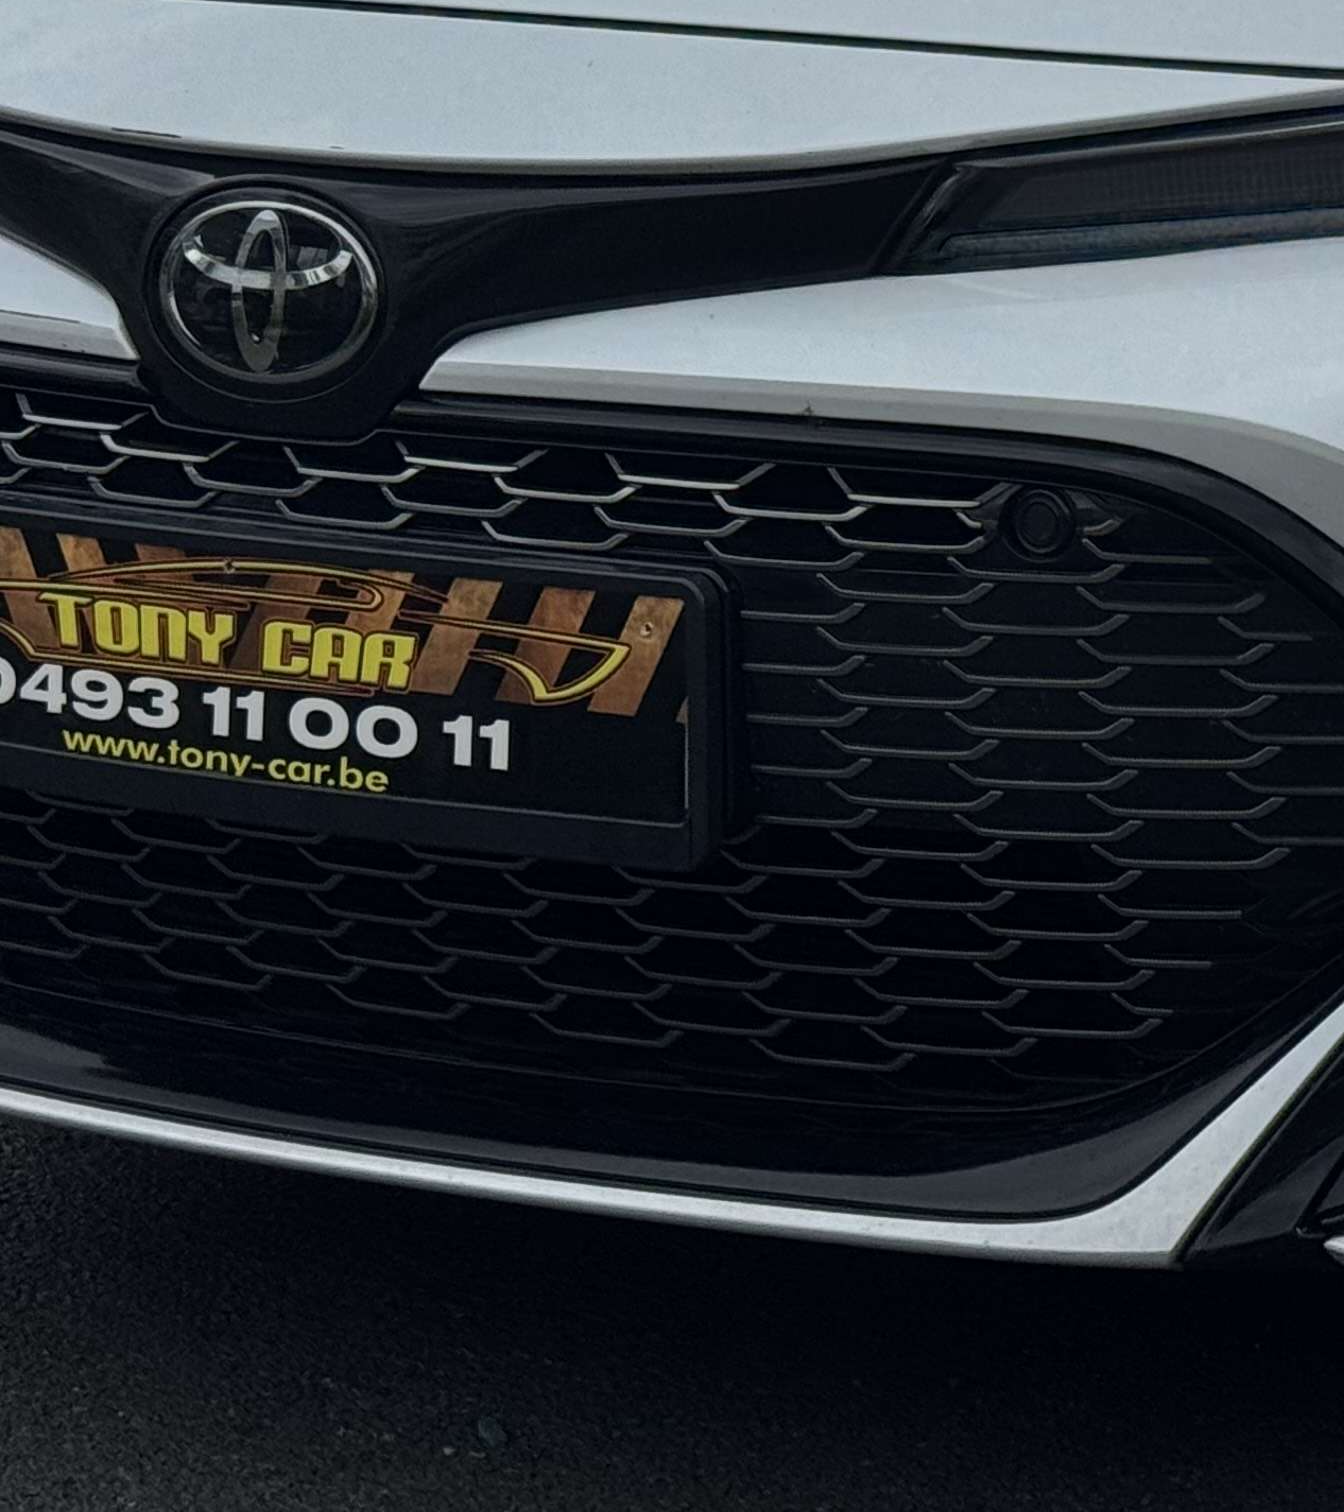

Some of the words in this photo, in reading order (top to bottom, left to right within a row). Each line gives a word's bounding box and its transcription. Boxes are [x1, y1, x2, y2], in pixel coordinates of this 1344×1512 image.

[37, 591, 235, 665] TONY
[261, 620, 417, 689] CAR
[0, 655, 181, 730] 493
[203, 685, 266, 743] 11
[442, 714, 511, 772] 11
[61, 729, 390, 793] www.tony-car.be
